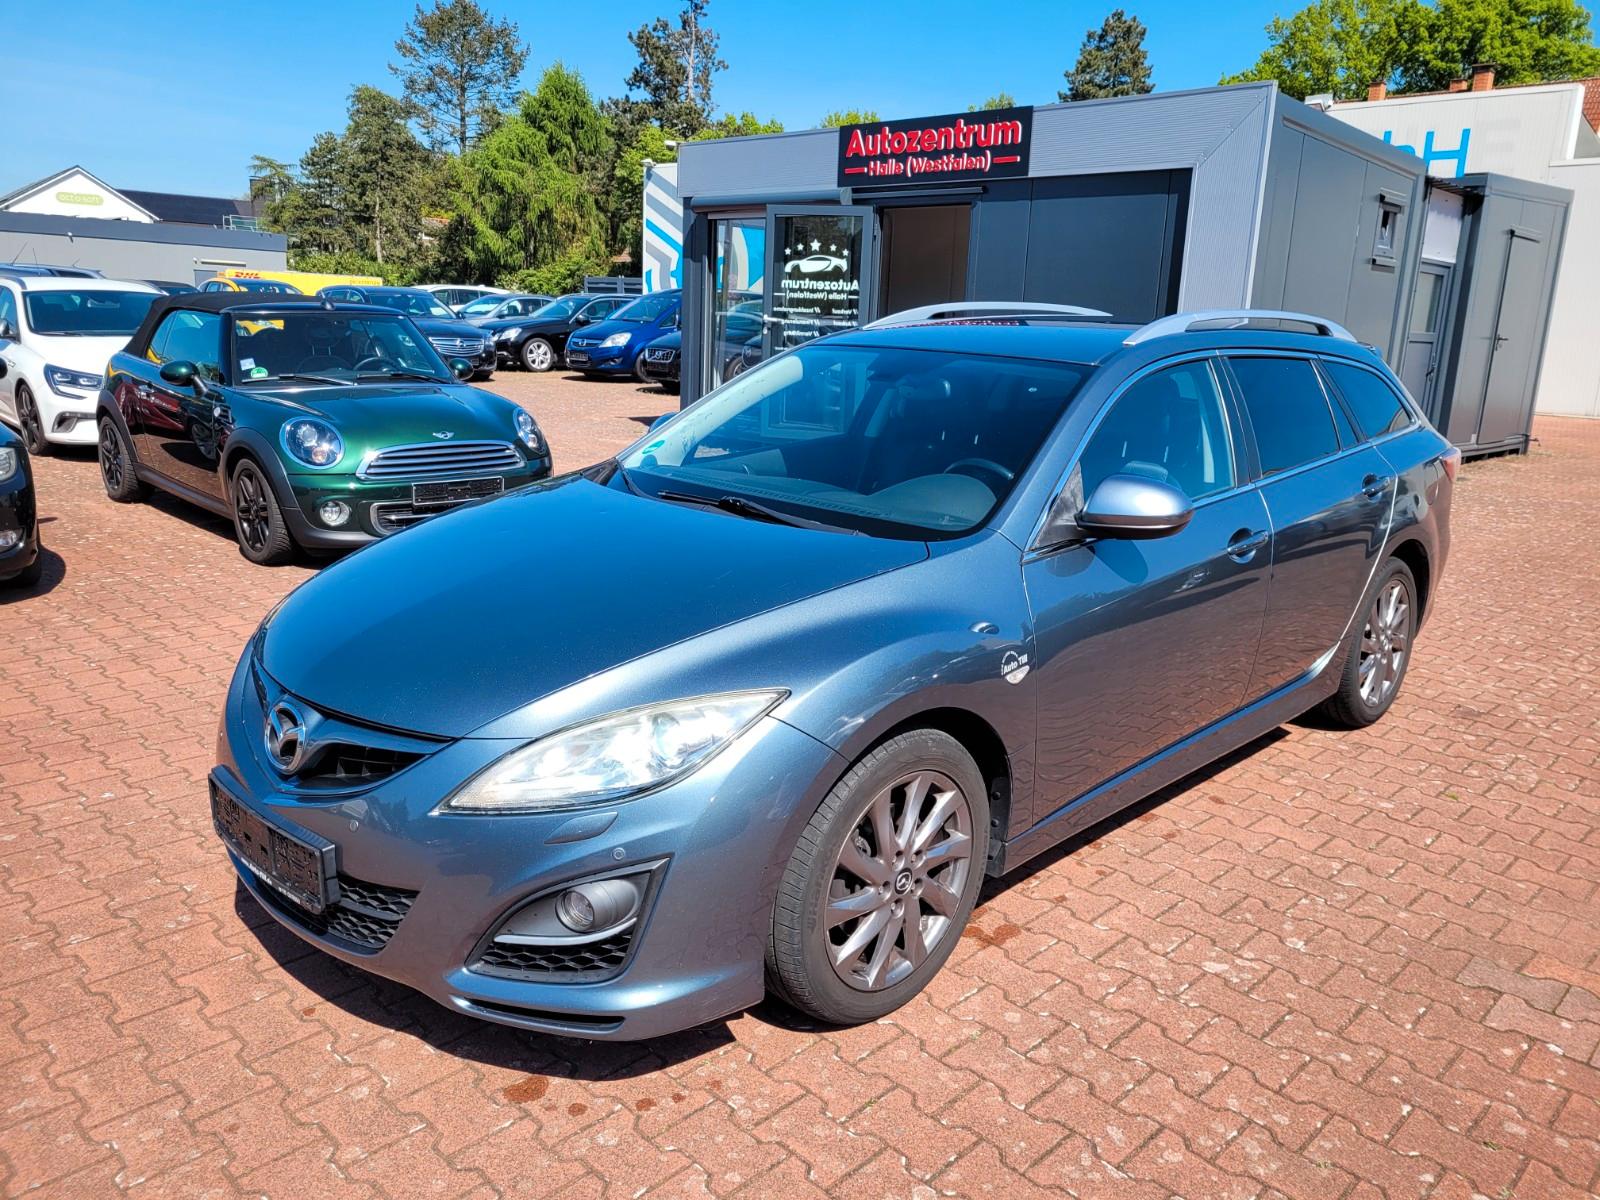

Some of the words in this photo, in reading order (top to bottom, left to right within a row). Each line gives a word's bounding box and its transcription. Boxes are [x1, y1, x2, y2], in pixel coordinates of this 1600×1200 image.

[846, 119, 1022, 157] Autozentrum
[868, 158, 903, 176] Halle
[906, 150, 991, 177] (Westfalen)
[1003, 661, 1018, 675] Auto
